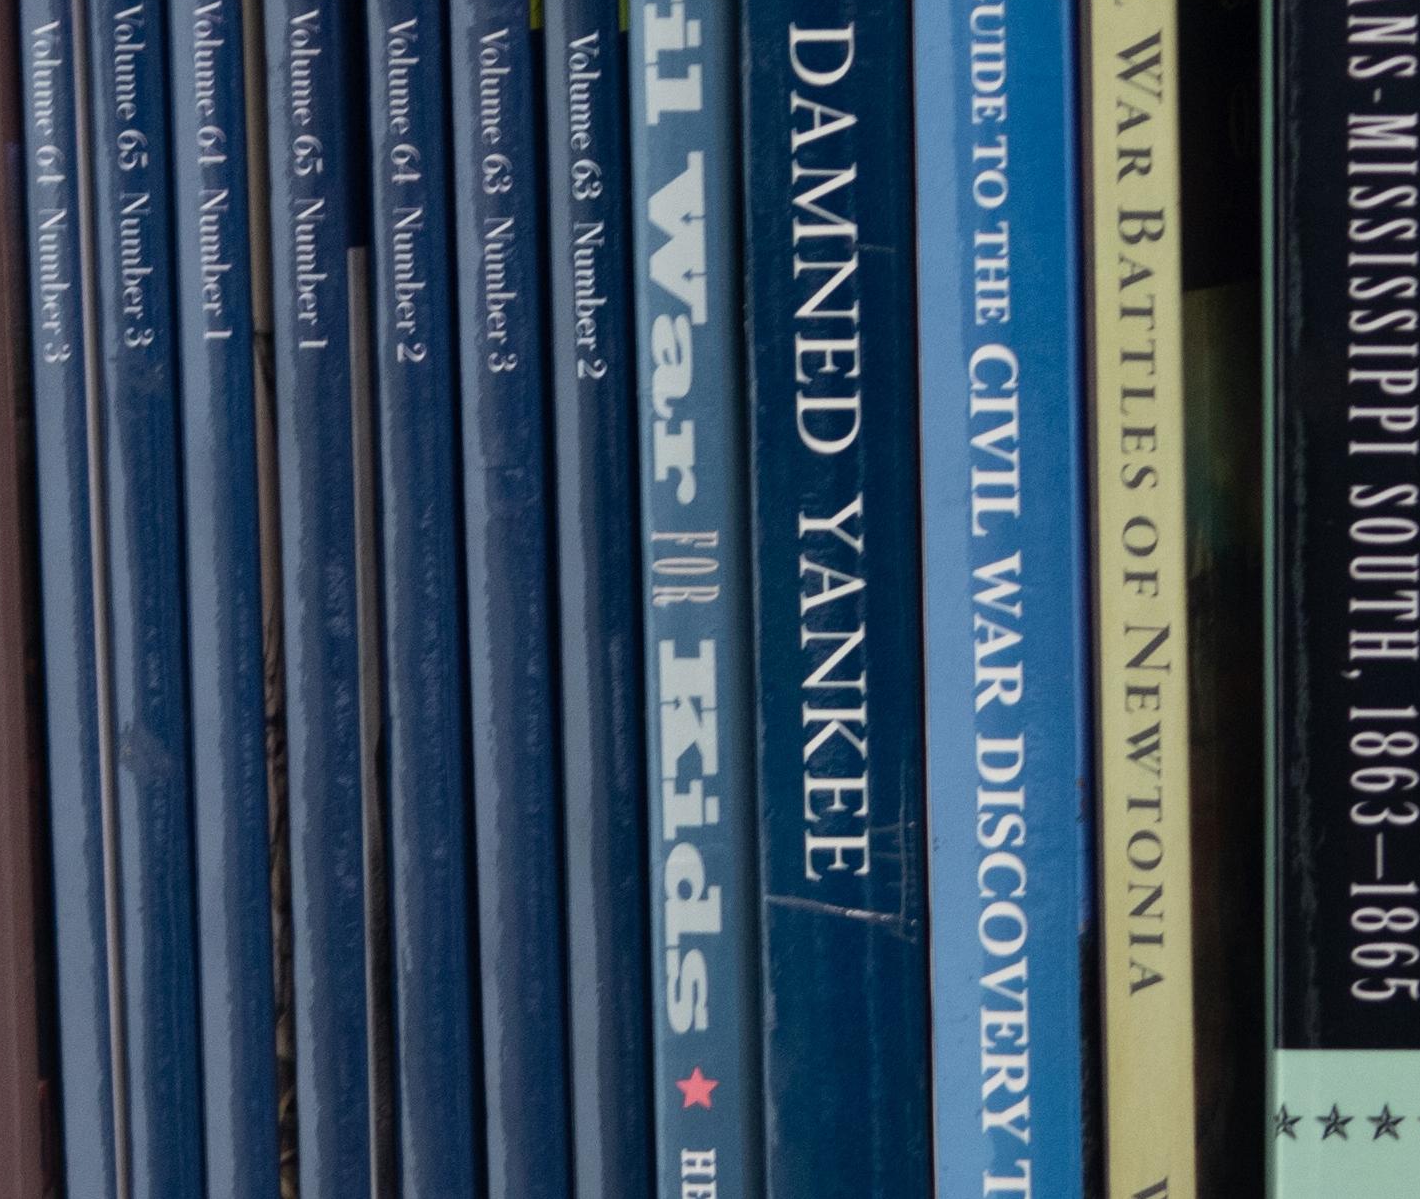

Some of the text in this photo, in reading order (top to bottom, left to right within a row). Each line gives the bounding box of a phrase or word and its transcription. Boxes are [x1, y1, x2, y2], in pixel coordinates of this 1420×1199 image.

[113, 3, 154, 350] Volume 65 Number 3
[193, 0, 233, 341] Volume 64 Number 1
[568, 30, 607, 380] Volume 63 Number 2
[971, 134, 1009, 209] TO
[1114, 29, 1164, 182] WAR
[648, 151, 708, 504] War
[973, 220, 1010, 325] THE
[1117, 208, 1166, 491] BATTLES
[651, 530, 719, 607] FOR
[788, 22, 870, 882] DAMNED YANKEE
[968, 342, 1022, 537] CIVIL
[1120, 514, 1160, 599] OF
[971, 552, 1024, 713] WAR
[1341, 483, 1419, 680] SOUTH,
[658, 639, 722, 1035] Kids
[976, 735, 1032, 1145] DISCOVERY
[1122, 620, 1172, 996] NEWTONIA
